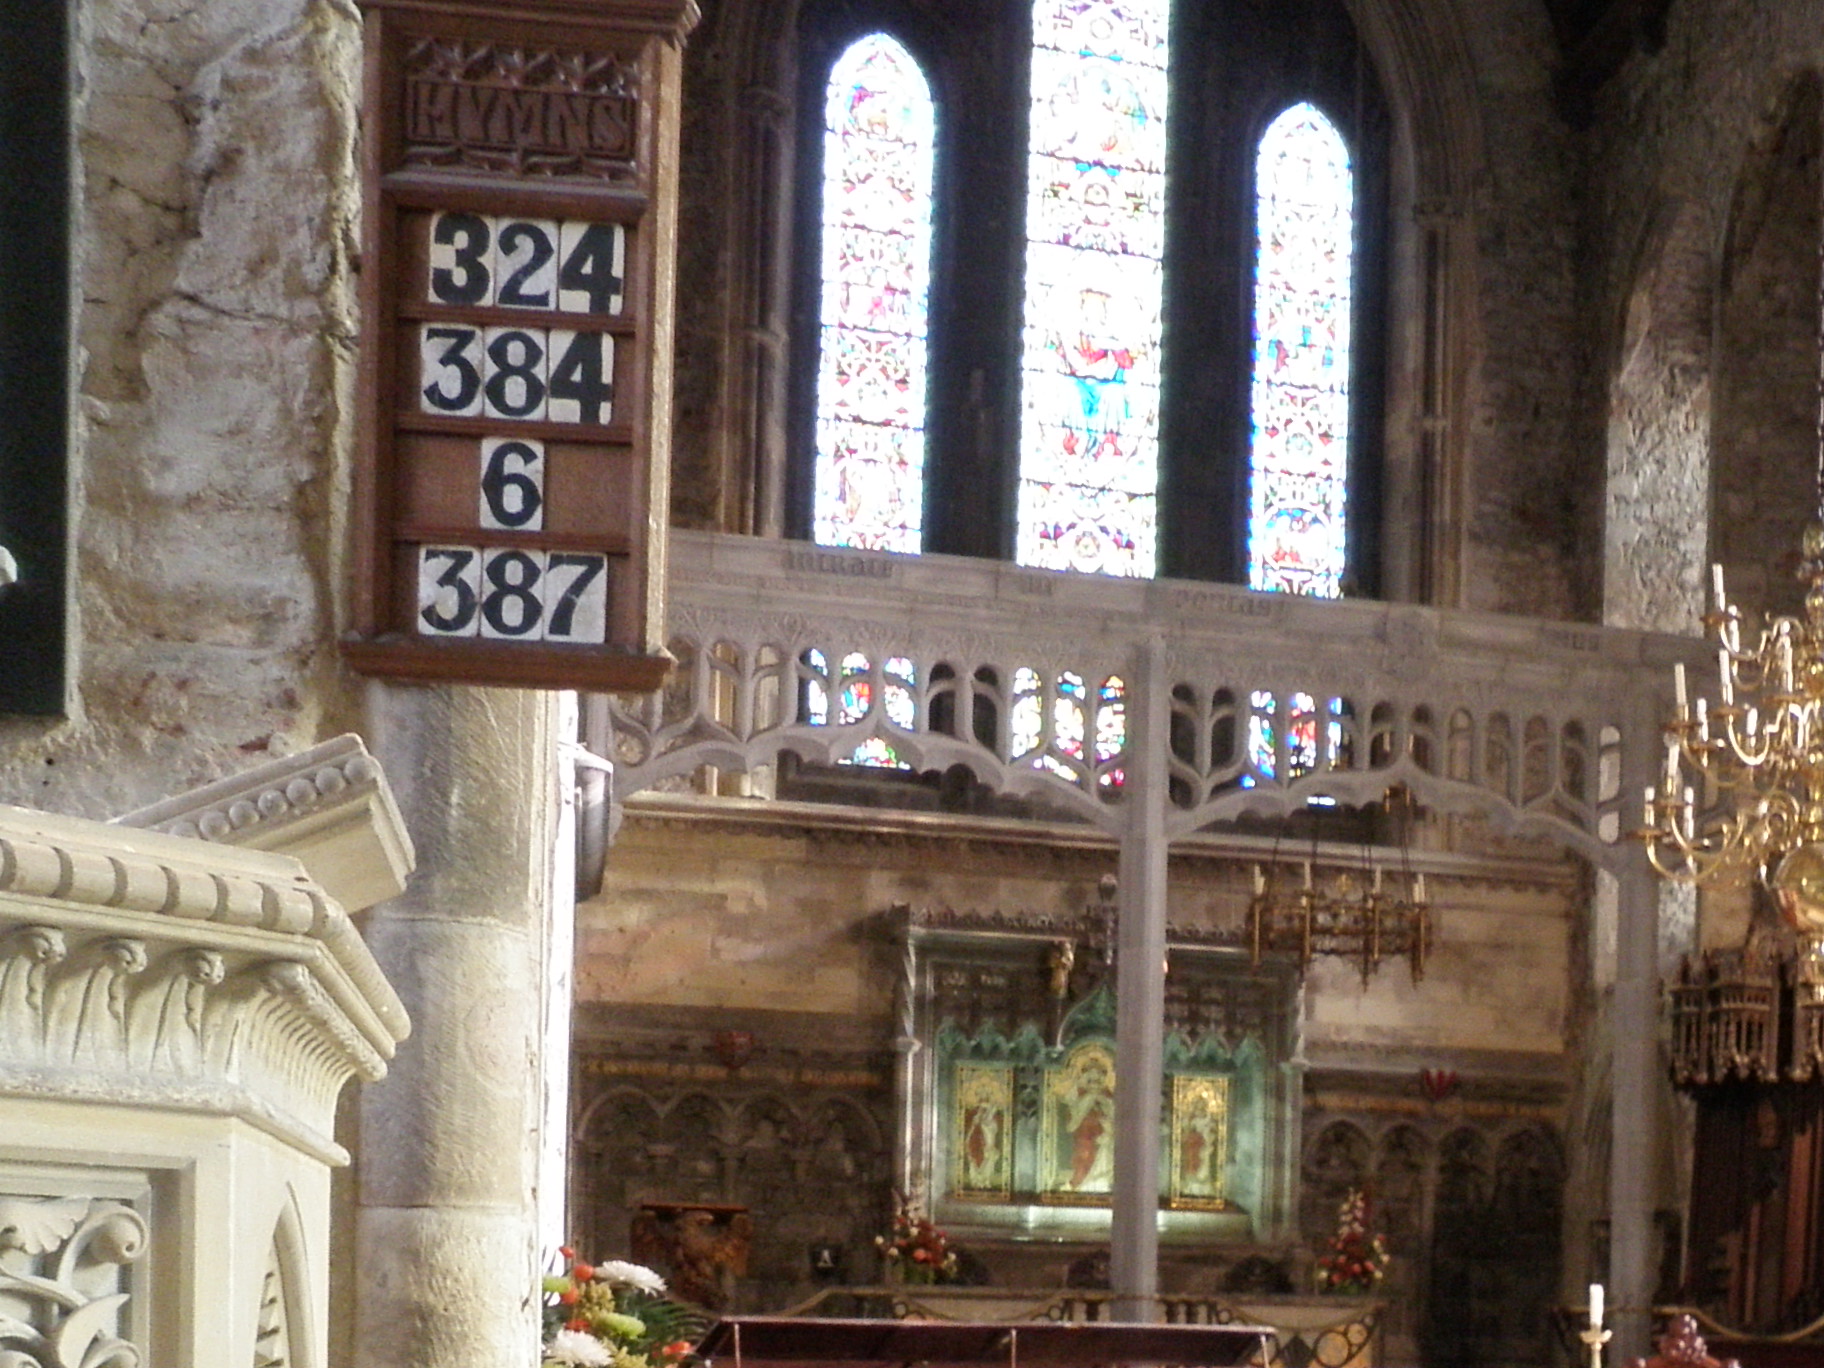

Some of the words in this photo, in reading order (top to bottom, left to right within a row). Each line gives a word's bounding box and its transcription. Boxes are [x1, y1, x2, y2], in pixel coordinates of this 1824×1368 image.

[410, 82, 630, 151] HYMNS
[433, 212, 621, 314] 324
[422, 328, 614, 424] 384
[482, 441, 542, 528] 6
[421, 547, 604, 636] 387
